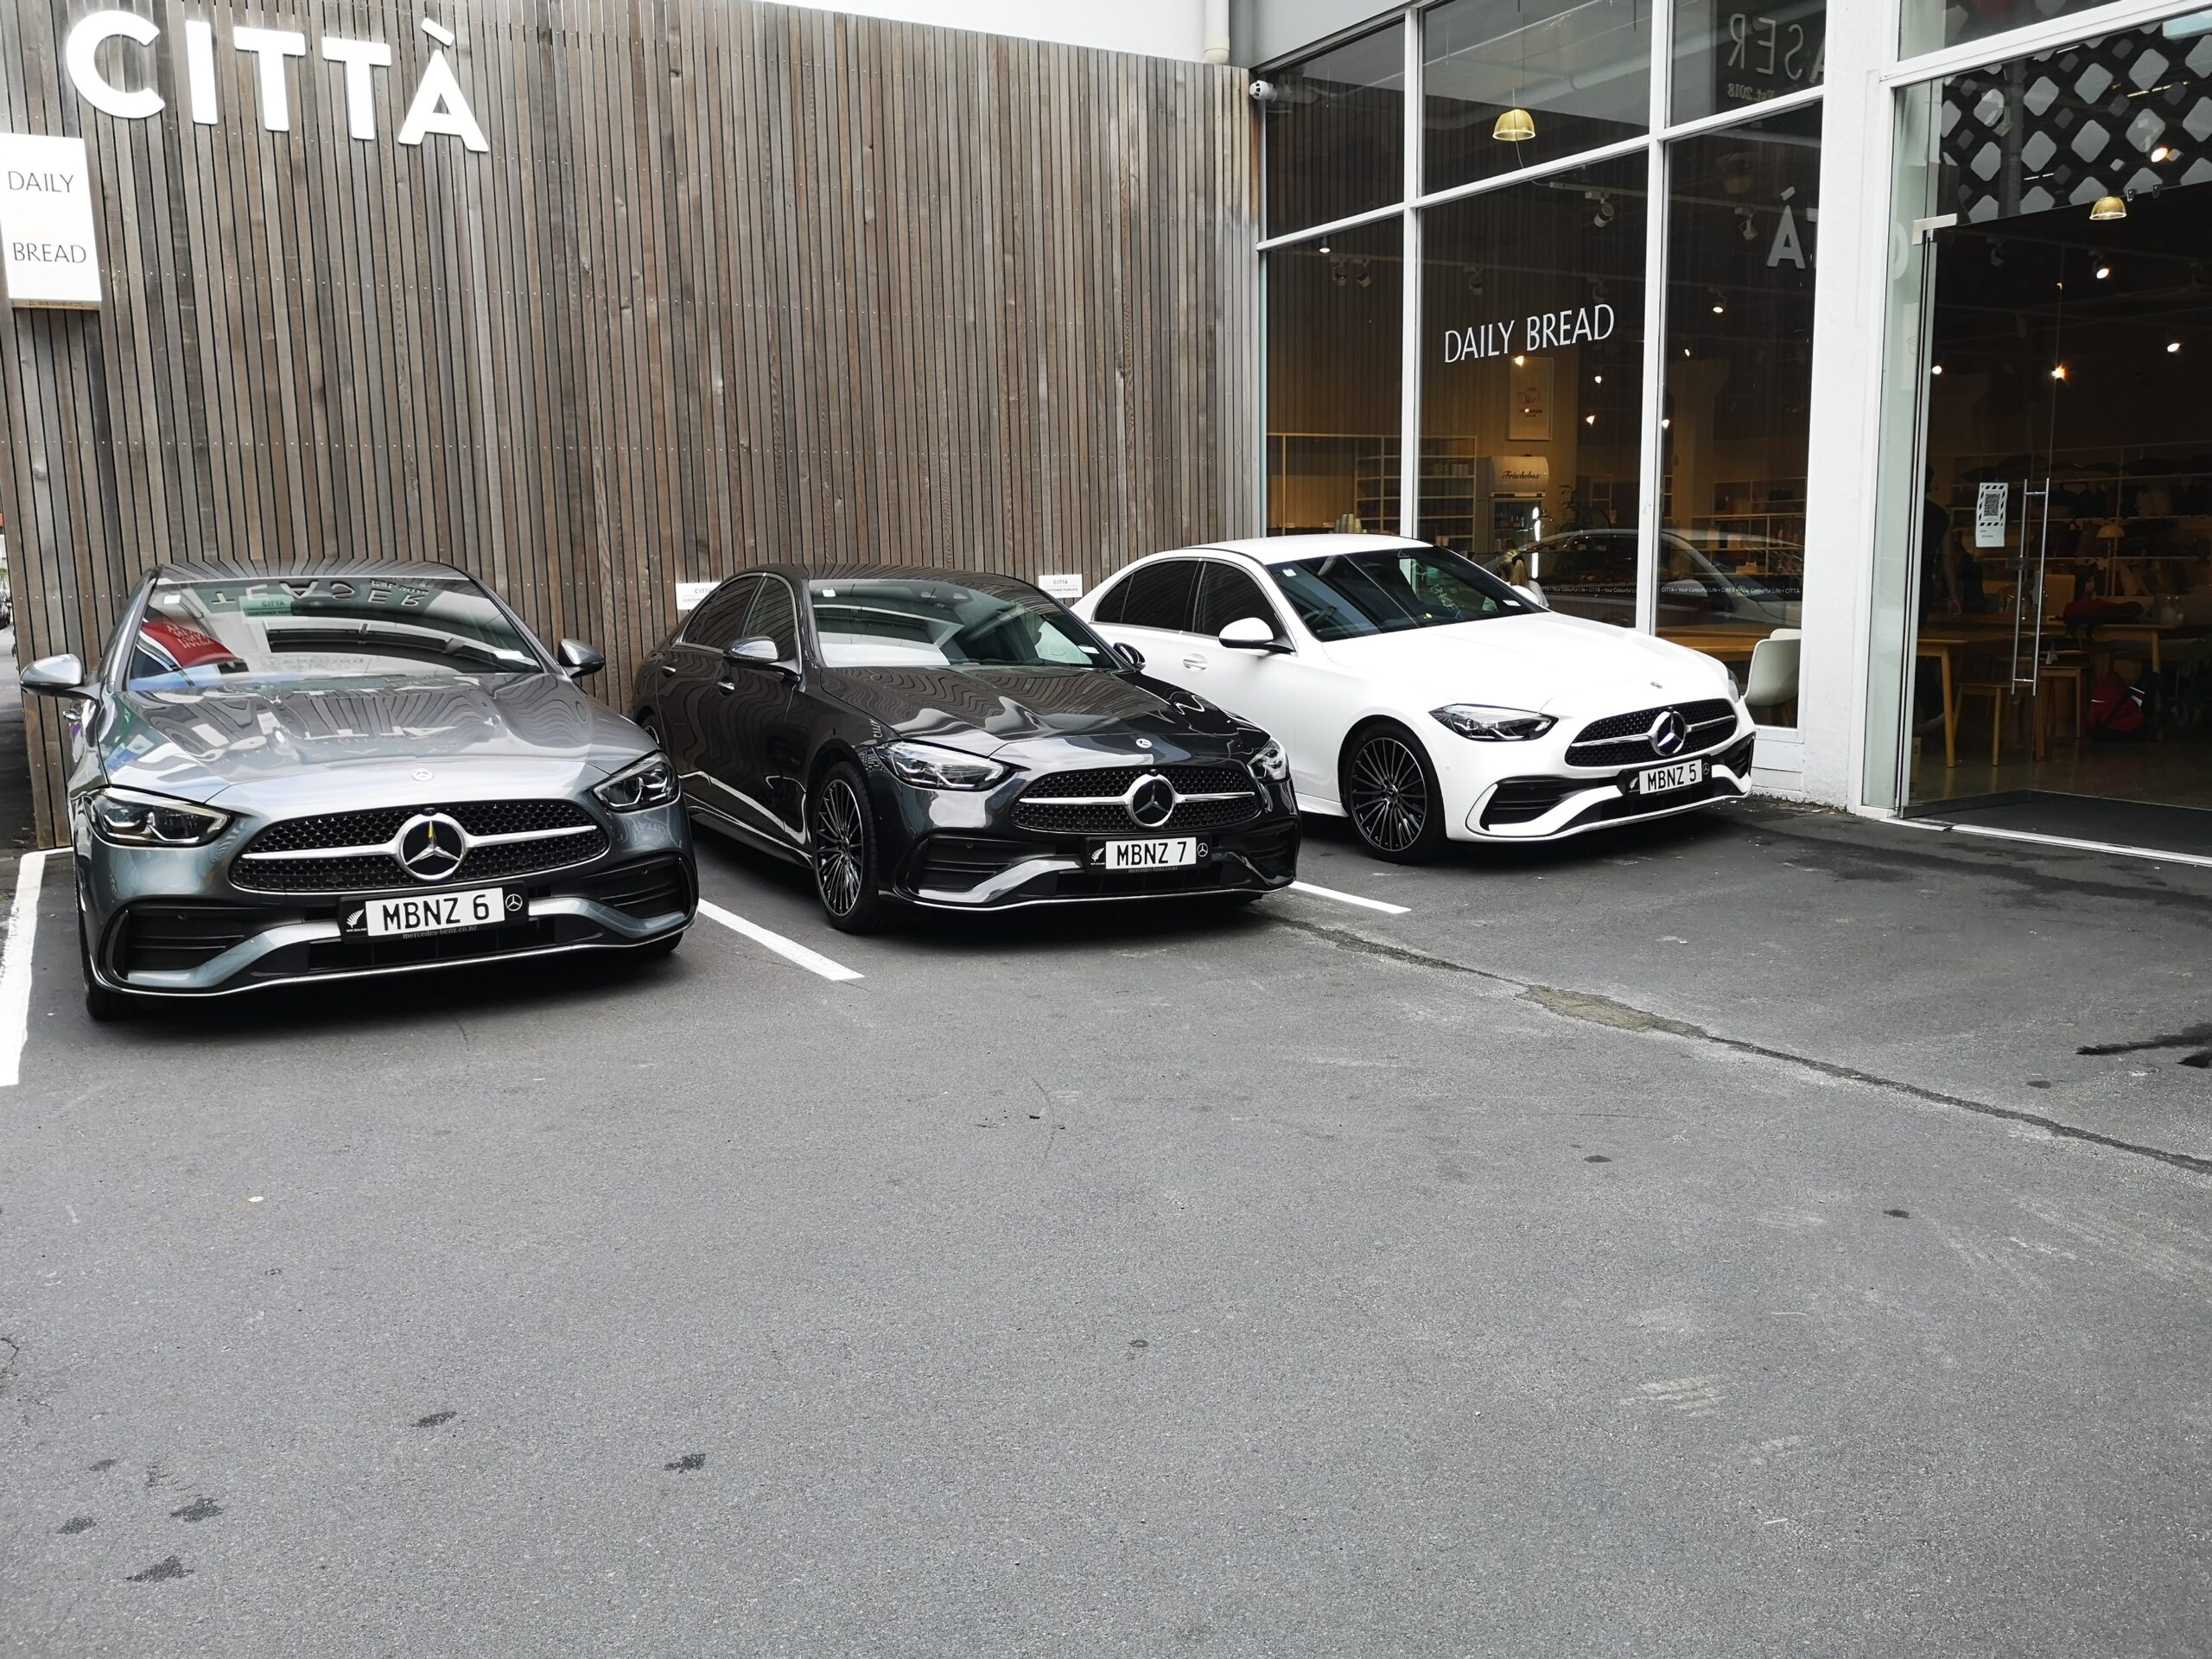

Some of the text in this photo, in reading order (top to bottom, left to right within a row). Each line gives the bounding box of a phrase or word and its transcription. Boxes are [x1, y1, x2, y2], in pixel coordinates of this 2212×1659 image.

[66, 10, 489, 153] CITTÀ
[8, 170, 73, 193] DAILY
[13, 242, 86, 264] BREAD
[1444, 303, 1615, 363] DAILY BREAD
[1648, 766, 1685, 791] MBNZ
[1689, 763, 1697, 782] 5
[1117, 841, 1187, 867] MBNZ 7
[383, 893, 490, 931] MBNZ 6
[403, 925, 478, 939] mercedes-benz.co.nz
